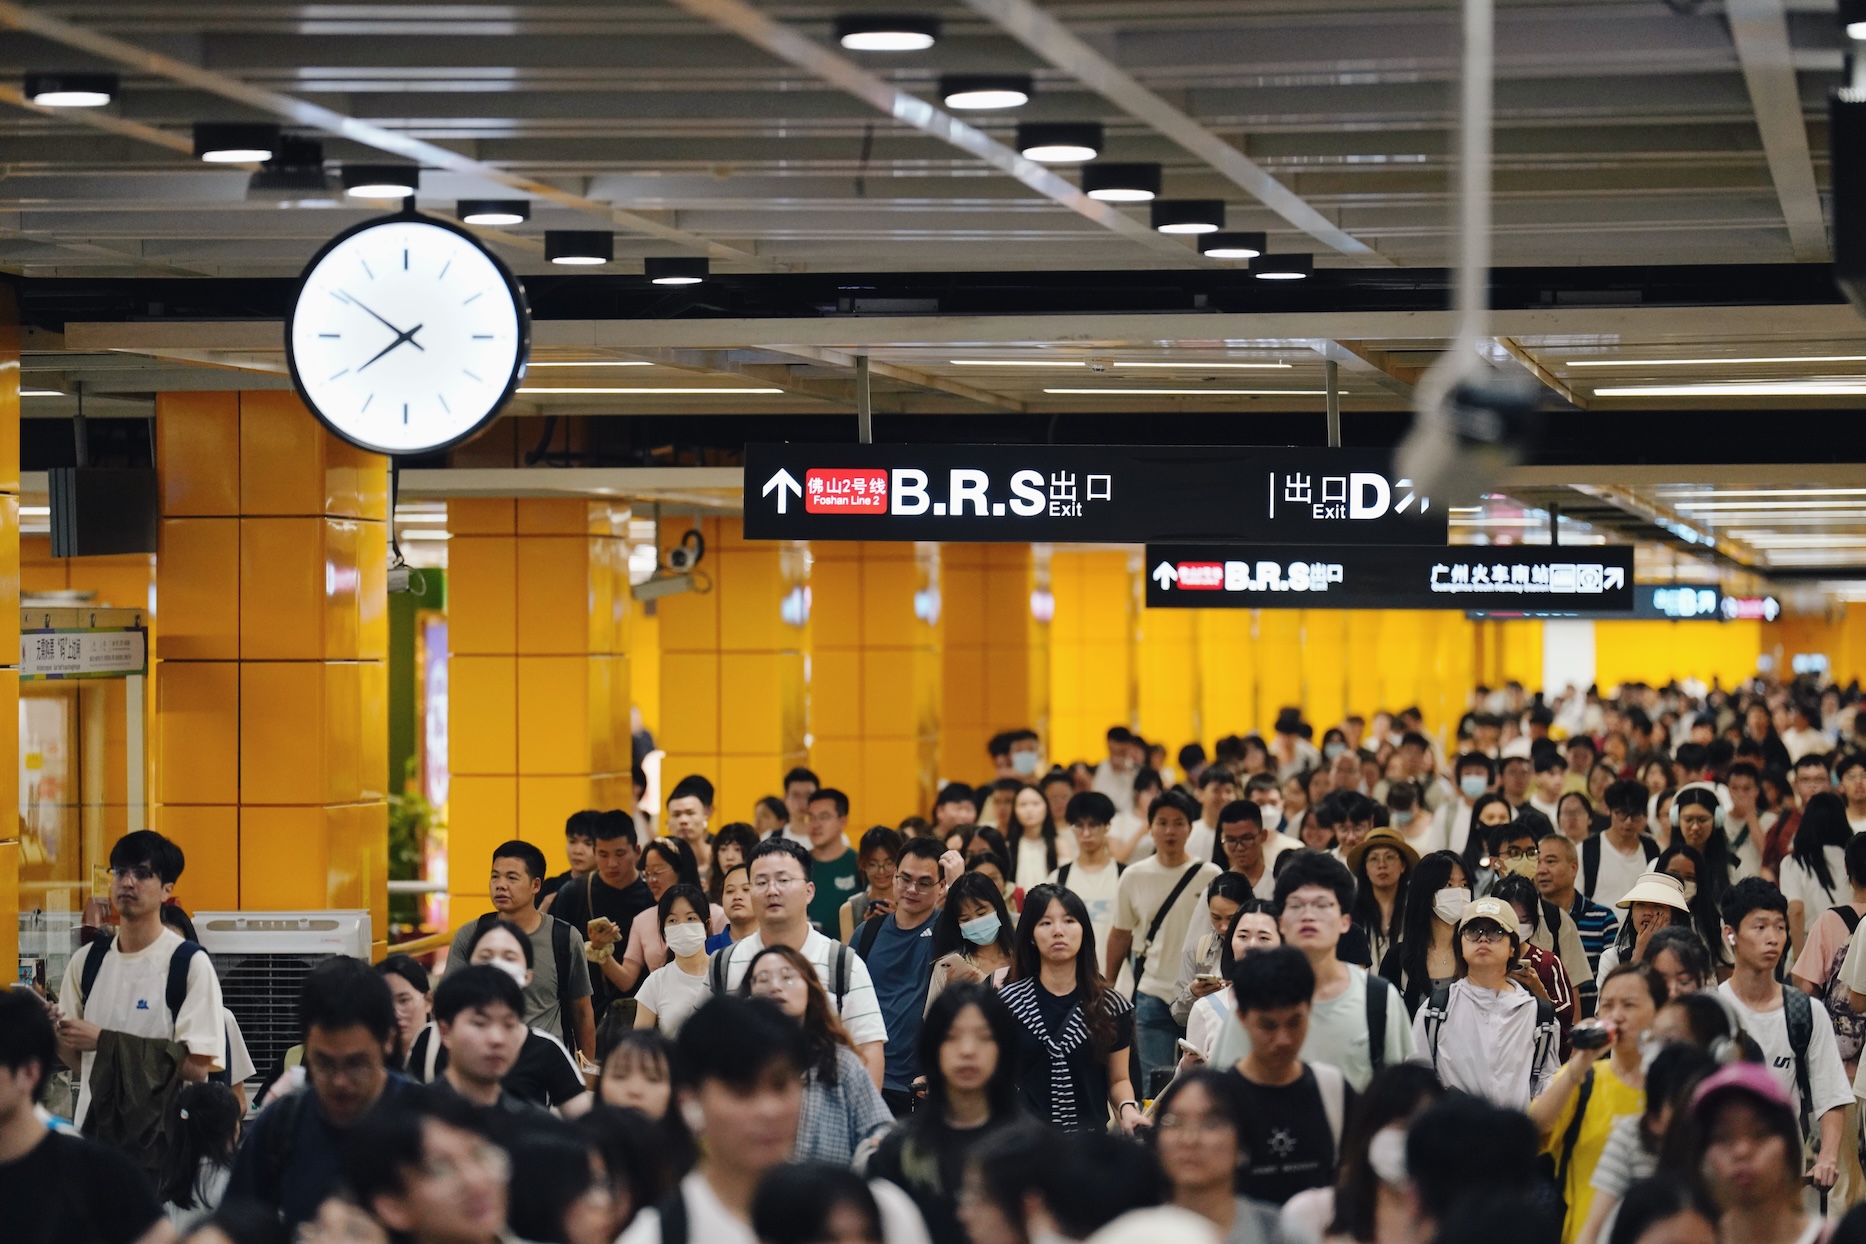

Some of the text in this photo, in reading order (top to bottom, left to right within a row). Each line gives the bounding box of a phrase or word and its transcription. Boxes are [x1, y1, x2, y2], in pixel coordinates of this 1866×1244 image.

[807, 477, 886, 497] 佛山2号线
[891, 468, 1046, 517] B.R.S
[1049, 470, 1112, 502] 出口
[1285, 472, 1347, 505] 出口
[1349, 472, 1391, 520] D
[813, 495, 880, 506] Foshan Line 2
[1049, 501, 1083, 518] Exit
[1312, 503, 1346, 520] Exit
[1224, 560, 1311, 592] B.R.S
[1430, 562, 1549, 584] 广州火车南站
